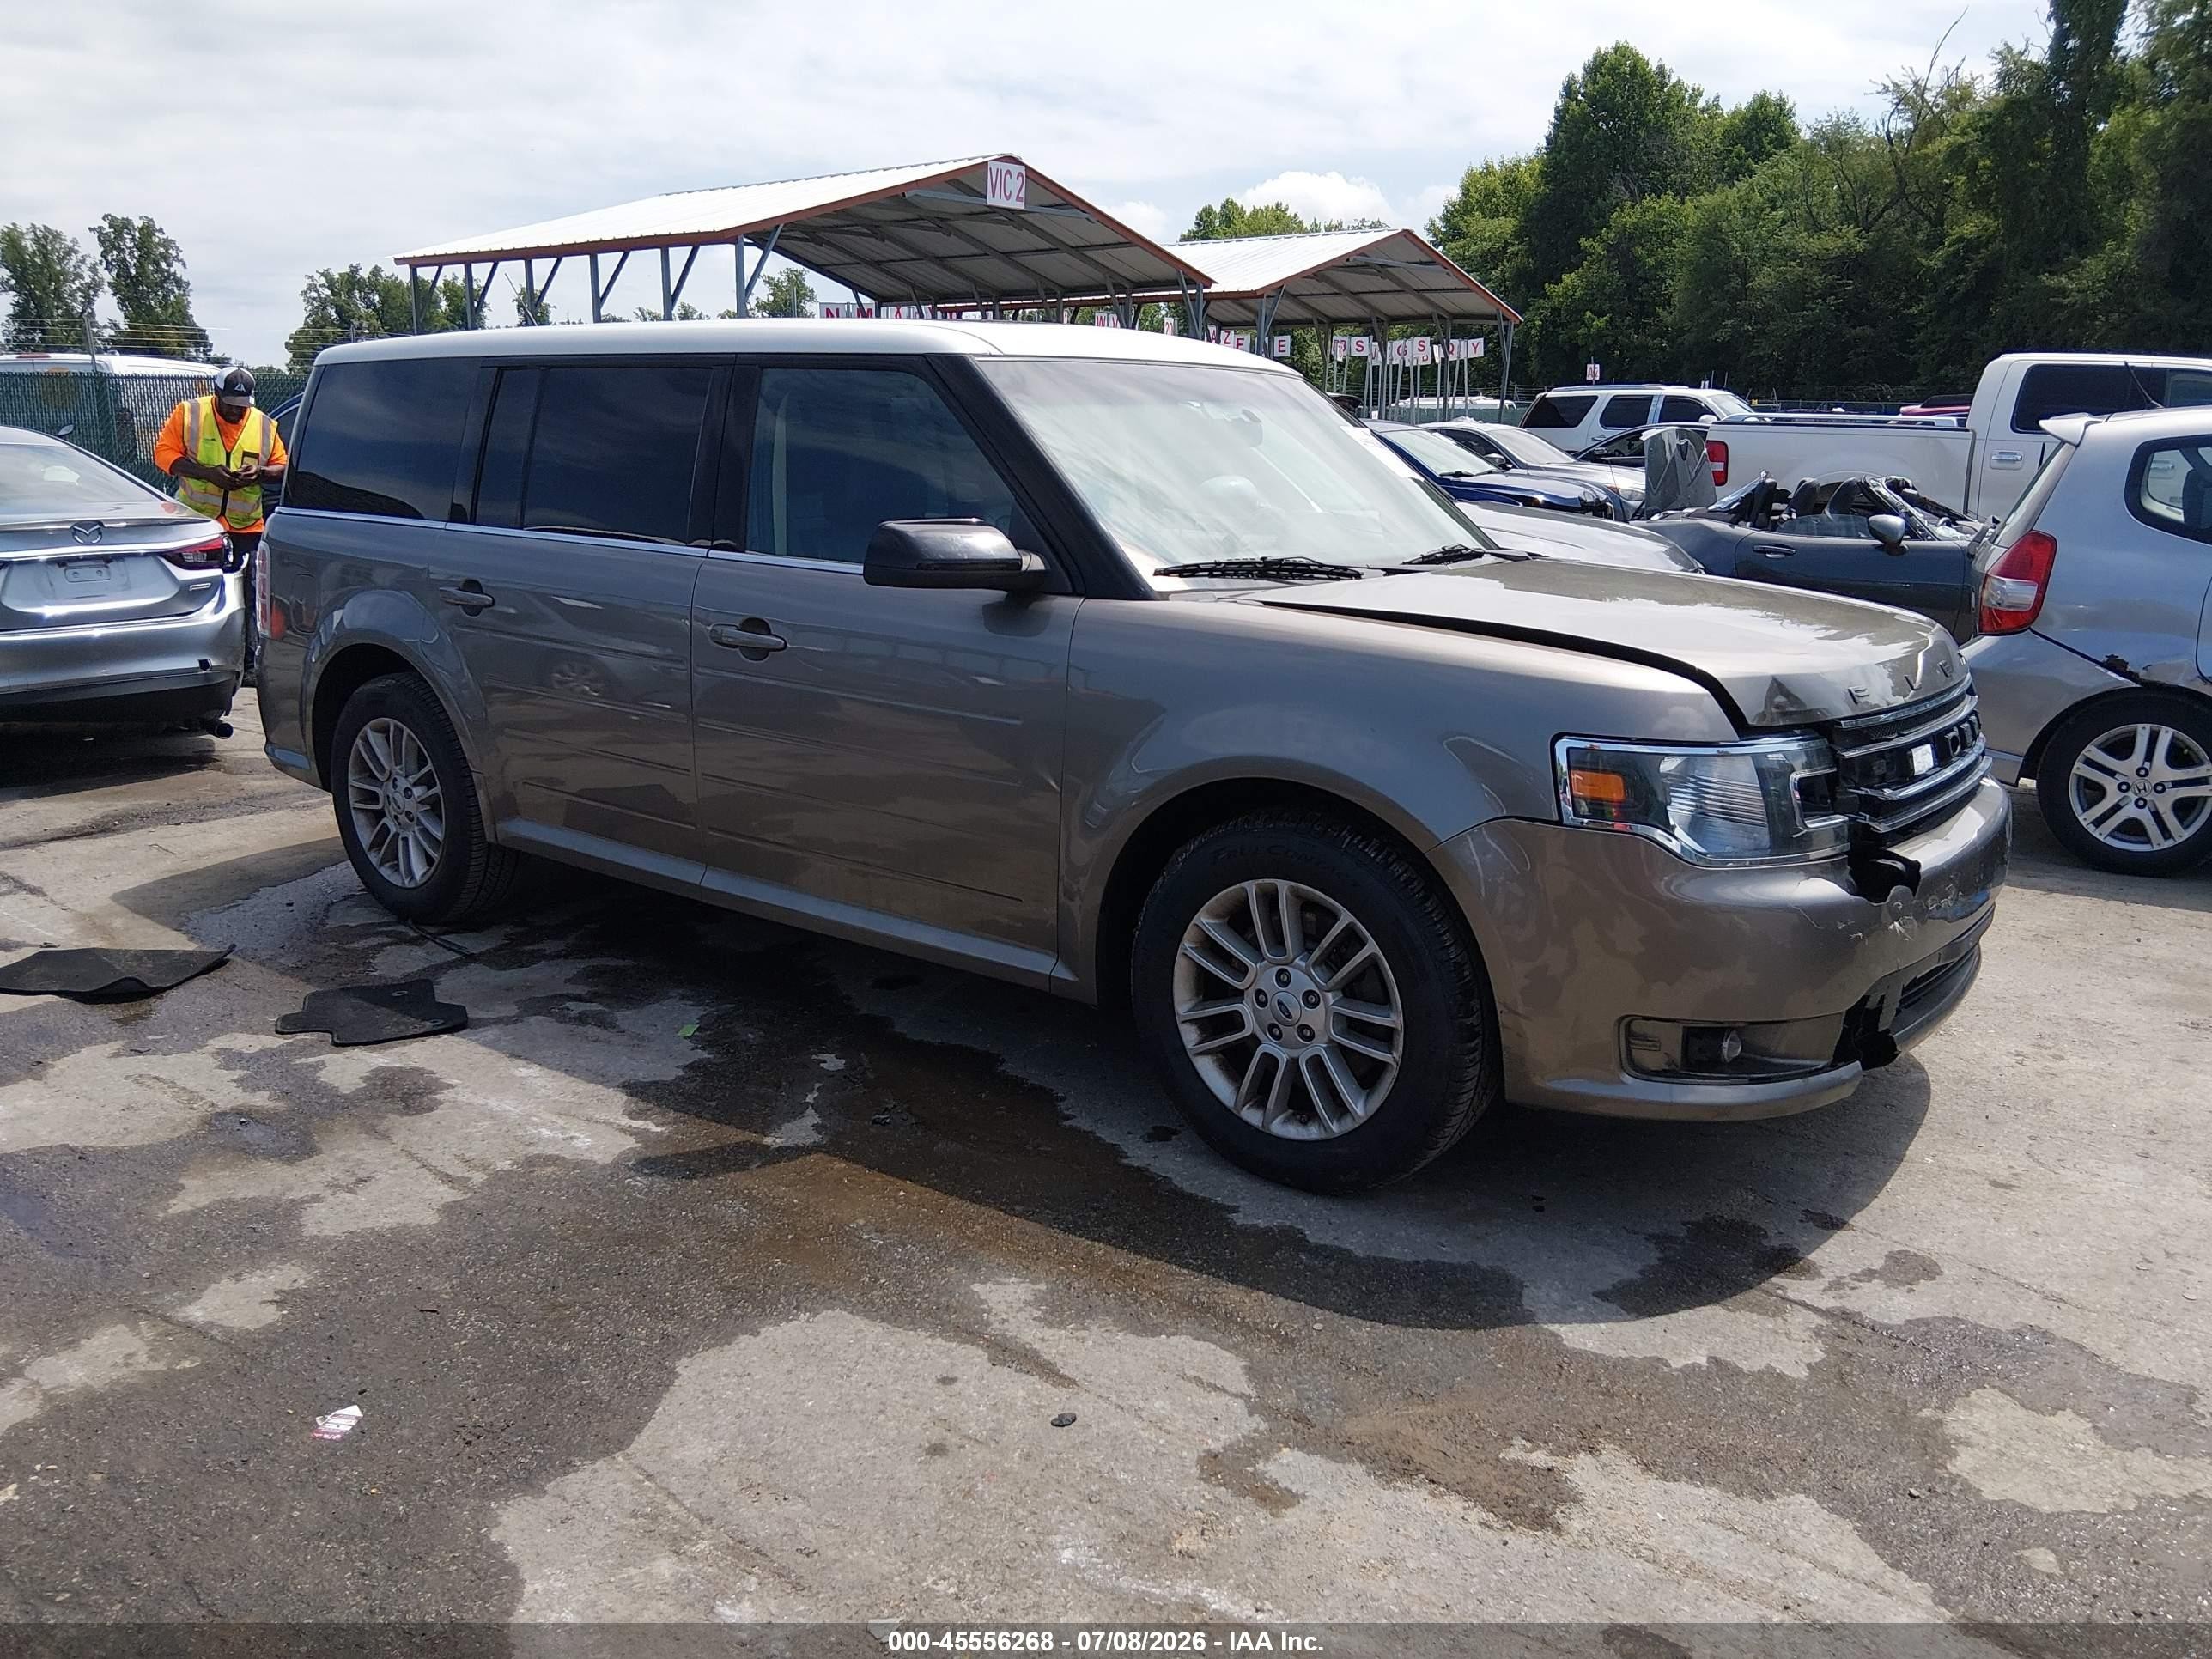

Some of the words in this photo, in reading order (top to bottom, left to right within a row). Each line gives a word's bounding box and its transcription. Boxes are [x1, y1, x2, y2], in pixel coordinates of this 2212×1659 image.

[988, 167, 1012, 201] VIC
[1016, 172, 1024, 202] 2
[1223, 330, 1231, 344] Z
[1278, 339, 1286, 353] E
[1355, 340, 1364, 353] S
[1417, 340, 1426, 352] S
[1471, 343, 1480, 354] Y
